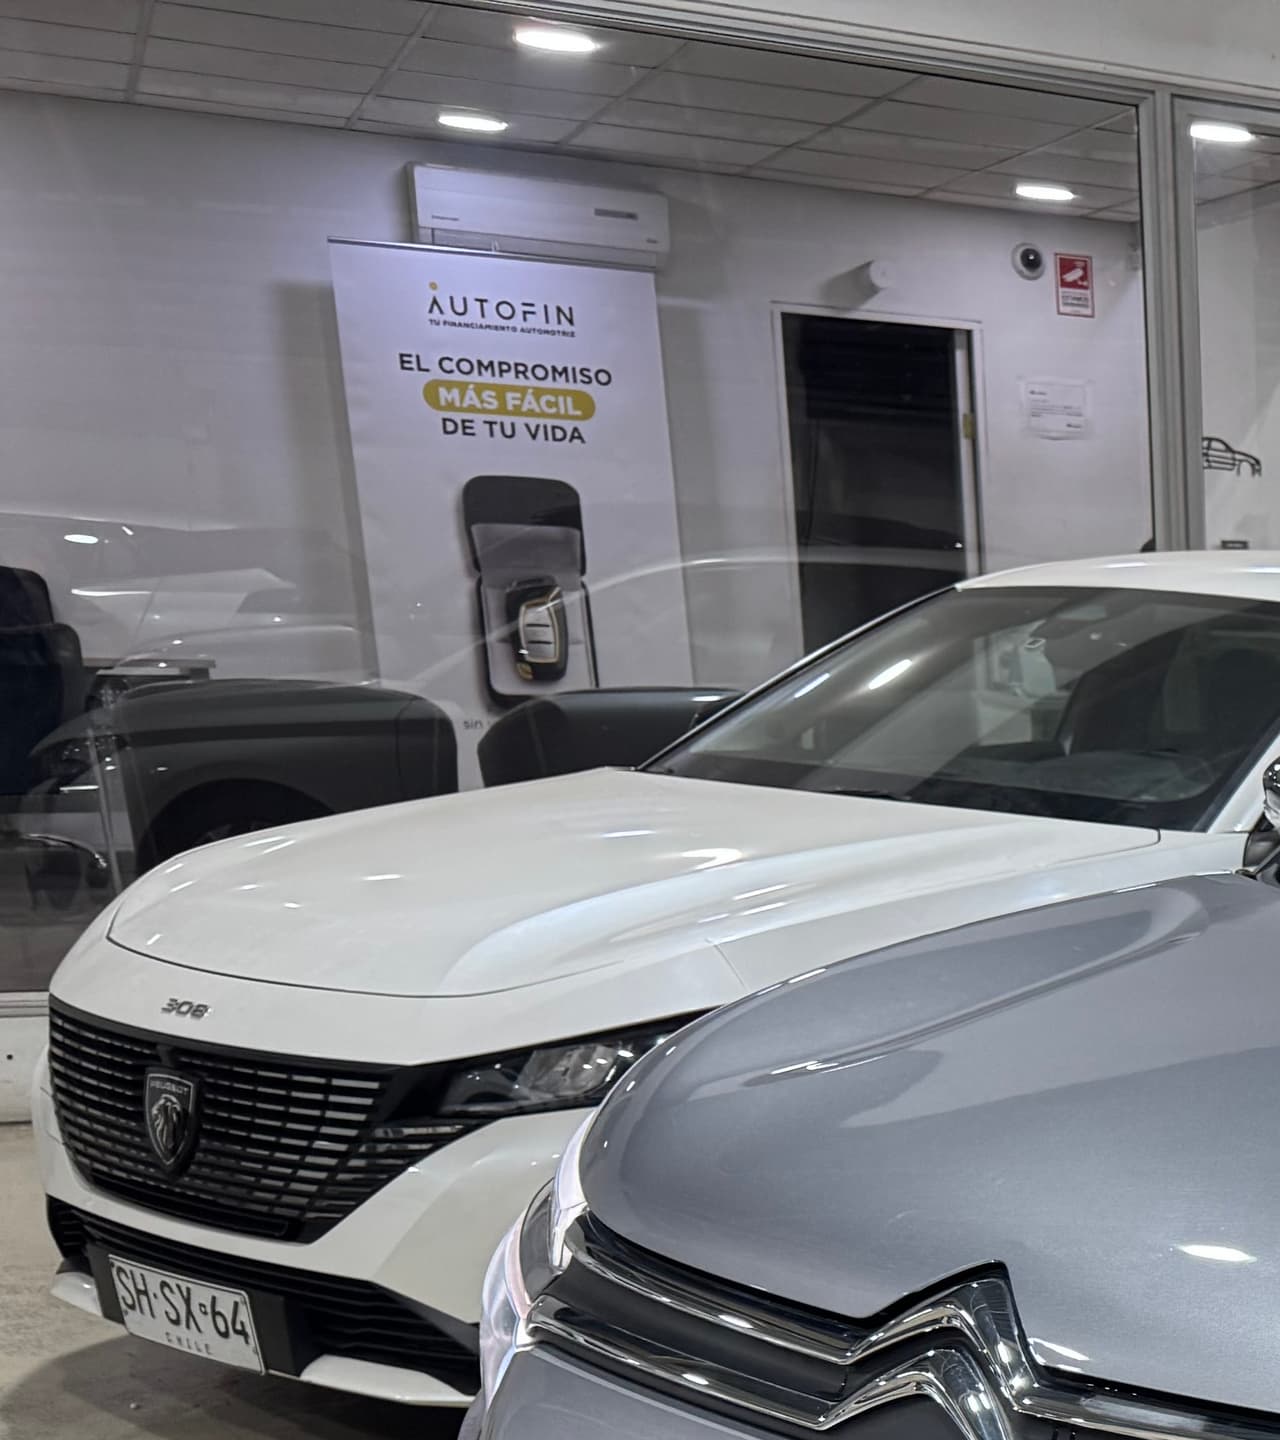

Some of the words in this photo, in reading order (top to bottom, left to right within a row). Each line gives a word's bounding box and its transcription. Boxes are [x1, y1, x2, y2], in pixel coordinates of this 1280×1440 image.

[428, 294, 576, 327] AUTOFIN
[442, 320, 518, 333] FINANCIAMIENTO
[519, 327, 577, 338] AUTOMOTRIZ
[399, 352, 430, 374] EL
[438, 356, 613, 386] COMPROMISO
[437, 383, 498, 411] MÁS
[506, 386, 583, 417] FÁCIL
[441, 416, 476, 437] DE
[483, 419, 517, 440] TU
[524, 422, 586, 444] VIDA
[161, 997, 209, 1018] 308
